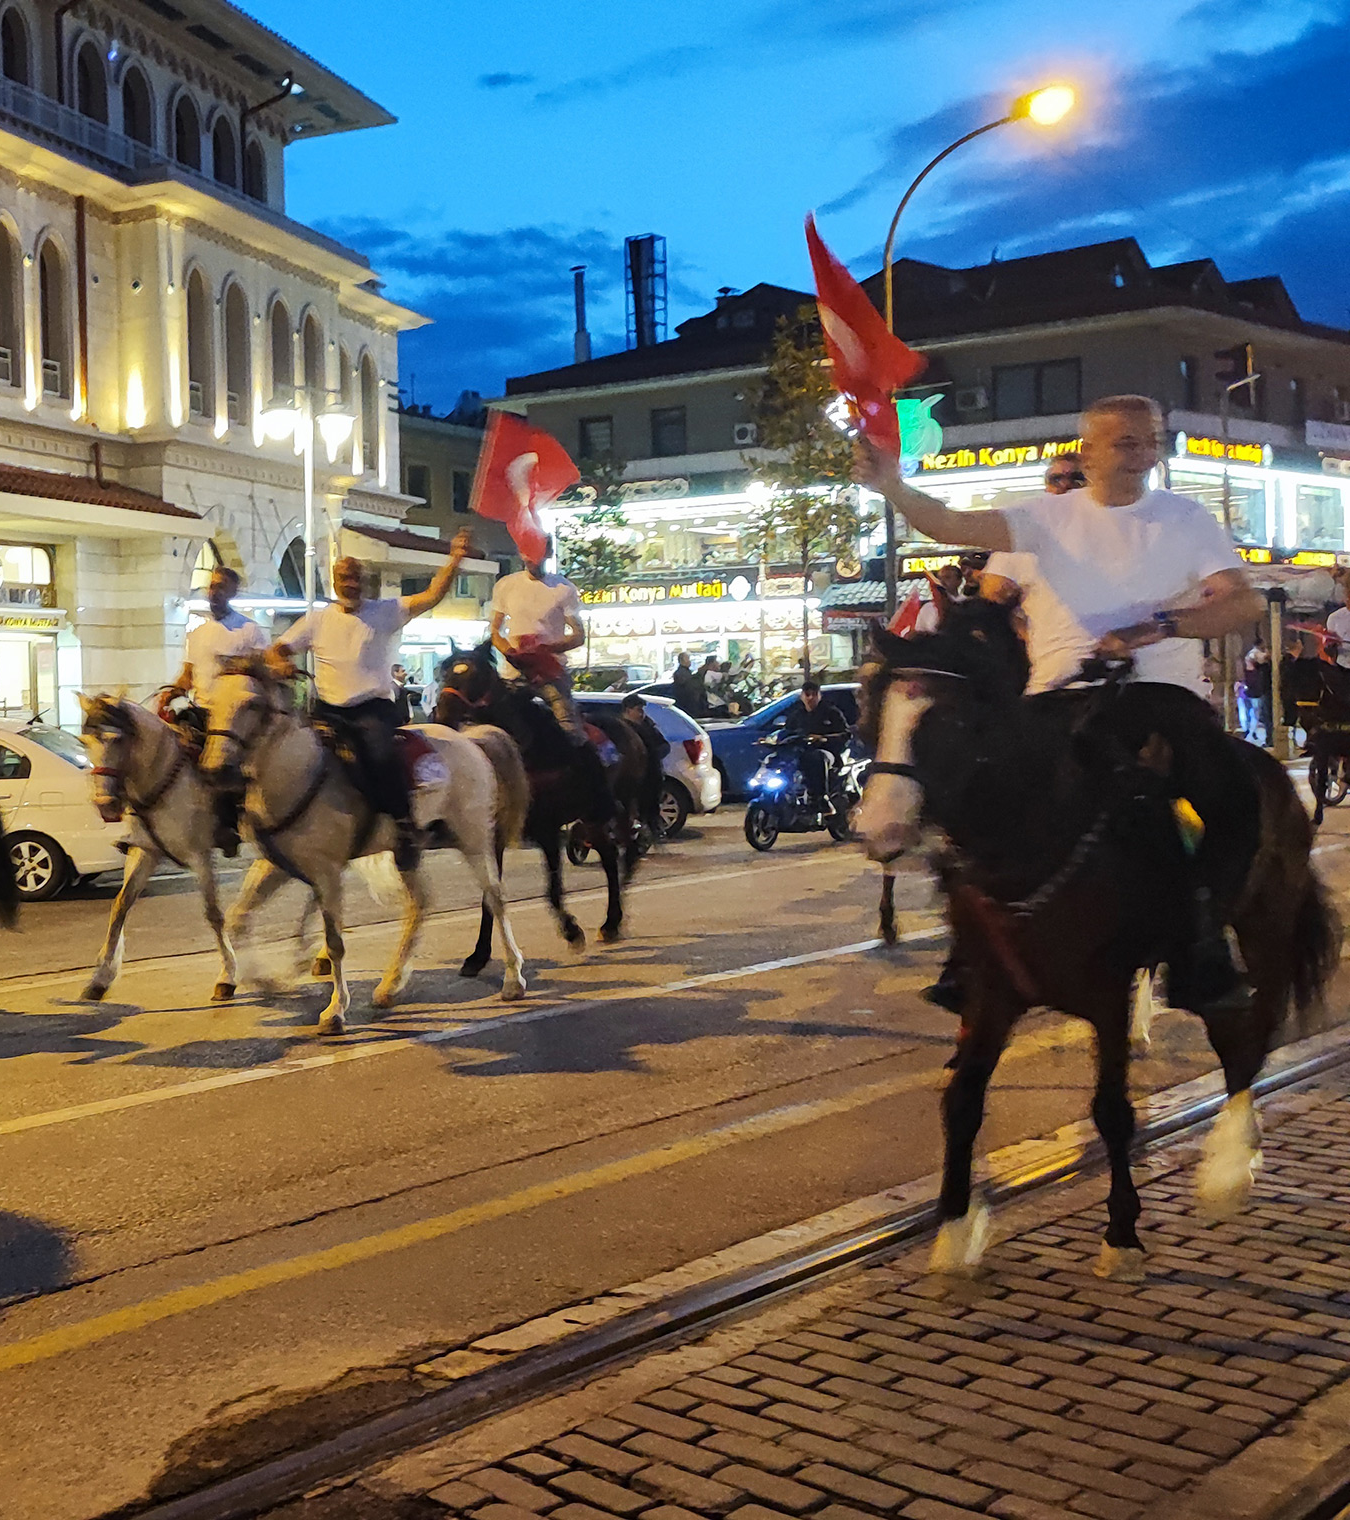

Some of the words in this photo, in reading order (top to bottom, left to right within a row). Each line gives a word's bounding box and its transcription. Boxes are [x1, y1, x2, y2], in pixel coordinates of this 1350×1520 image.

[922, 449, 976, 470] Nezih
[978, 446, 1039, 467] Konya
[619, 585, 666, 605] Konya
[669, 579, 728, 601] Mutfağı
